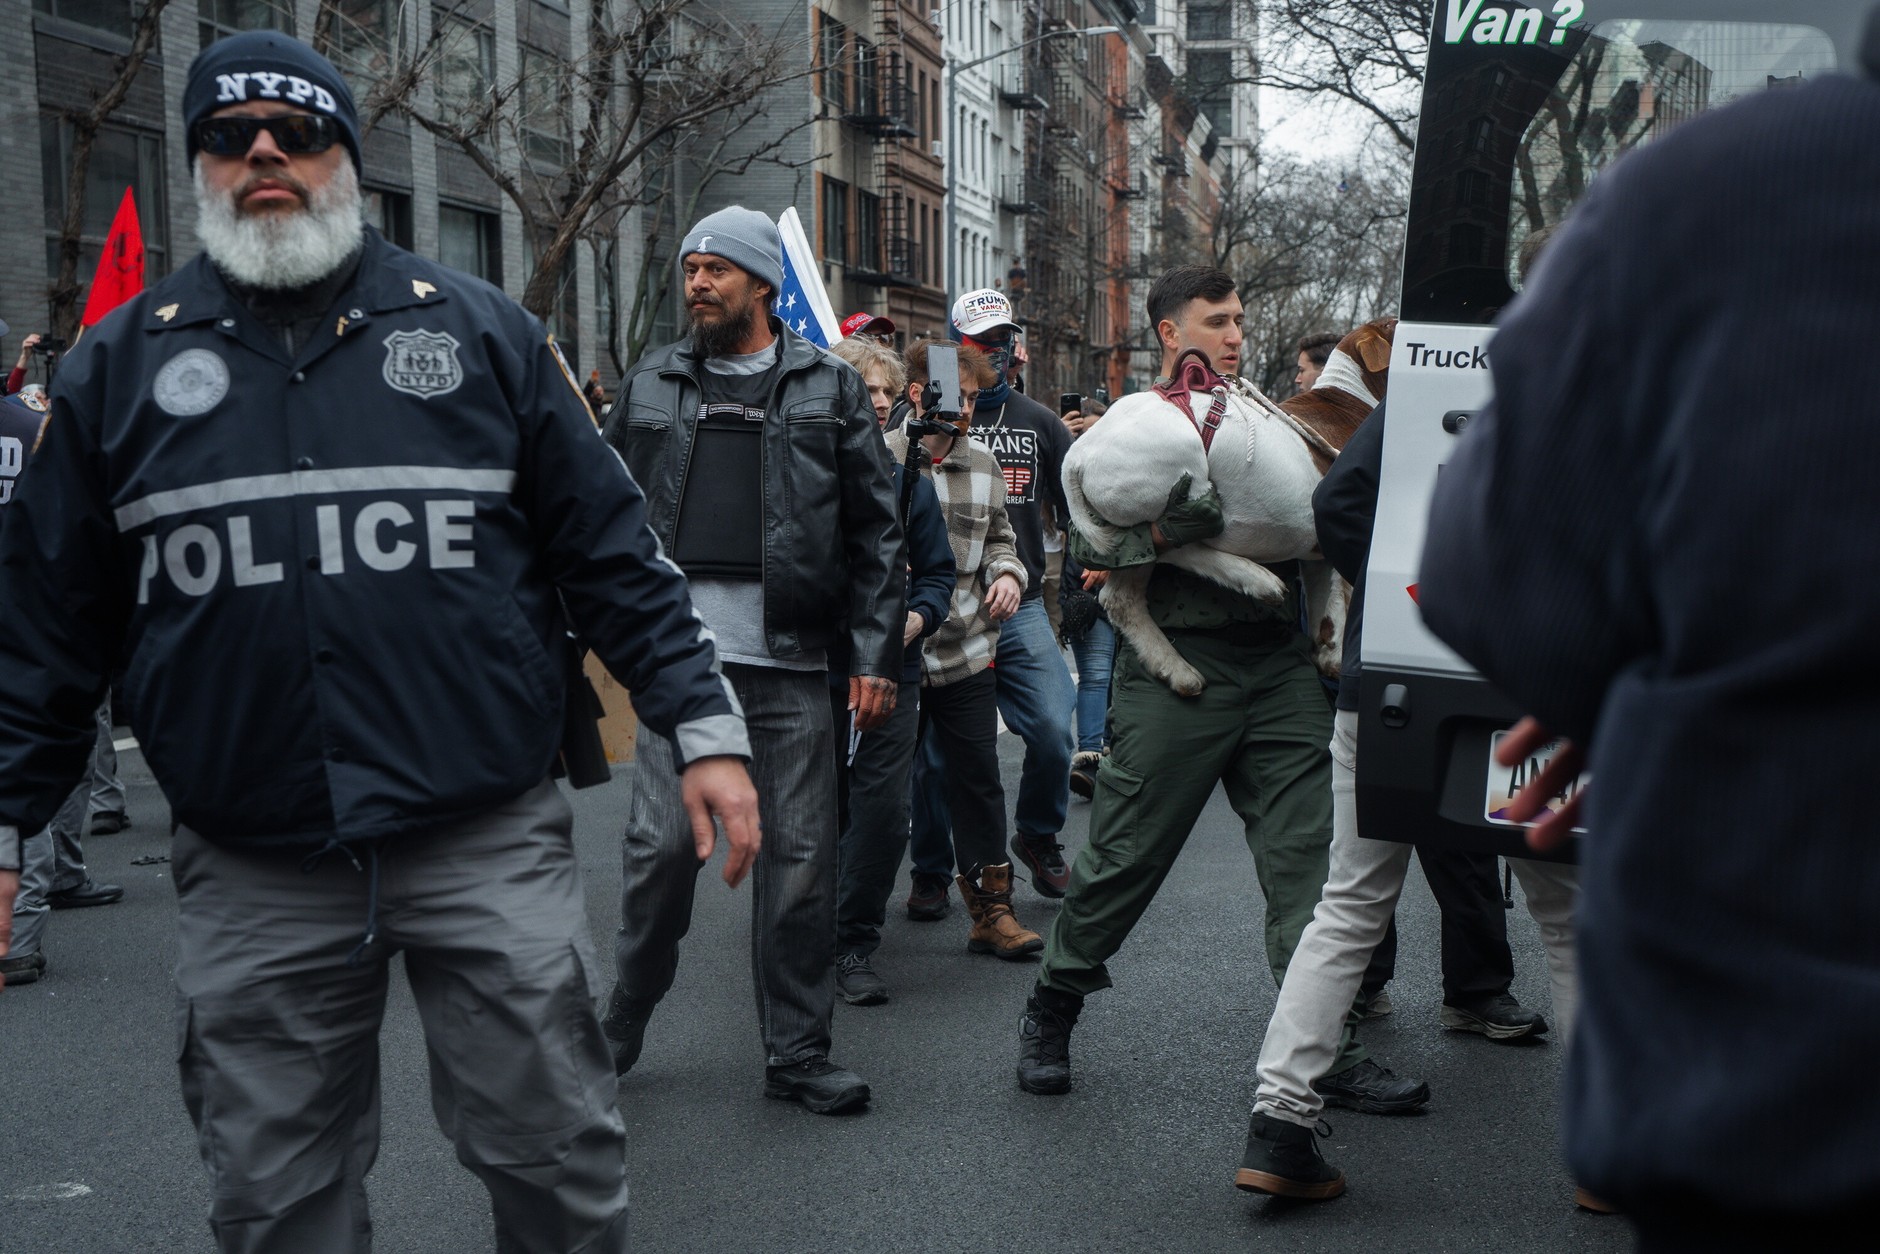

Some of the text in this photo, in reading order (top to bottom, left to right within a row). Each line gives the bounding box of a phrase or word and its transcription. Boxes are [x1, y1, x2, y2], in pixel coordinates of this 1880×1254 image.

[1445, 0, 1584, 45] Van?
[216, 71, 337, 113] NYPD
[969, 296, 1006, 306] TRUMP
[1406, 342, 1488, 370] Truck
[400, 375, 447, 387] NYPD
[1005, 496, 1026, 504] GREAT
